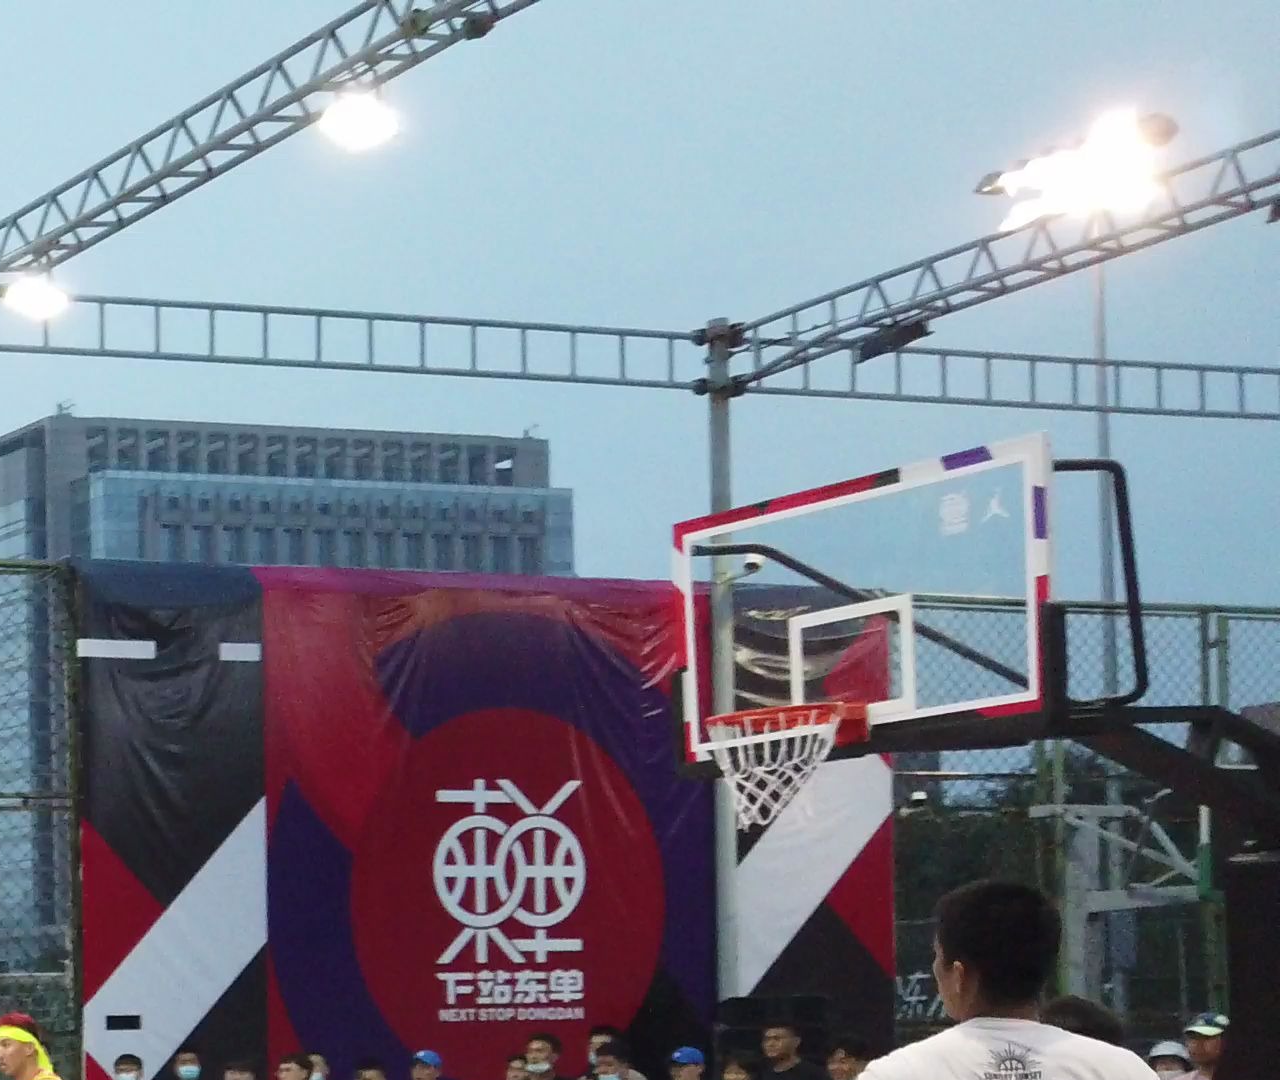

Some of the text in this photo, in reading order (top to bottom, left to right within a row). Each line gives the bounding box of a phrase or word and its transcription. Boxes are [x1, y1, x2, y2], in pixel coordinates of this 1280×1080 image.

[435, 969, 584, 1004] 下站东单
[438, 1007, 585, 1022] NEXT STOP DONGDAN
